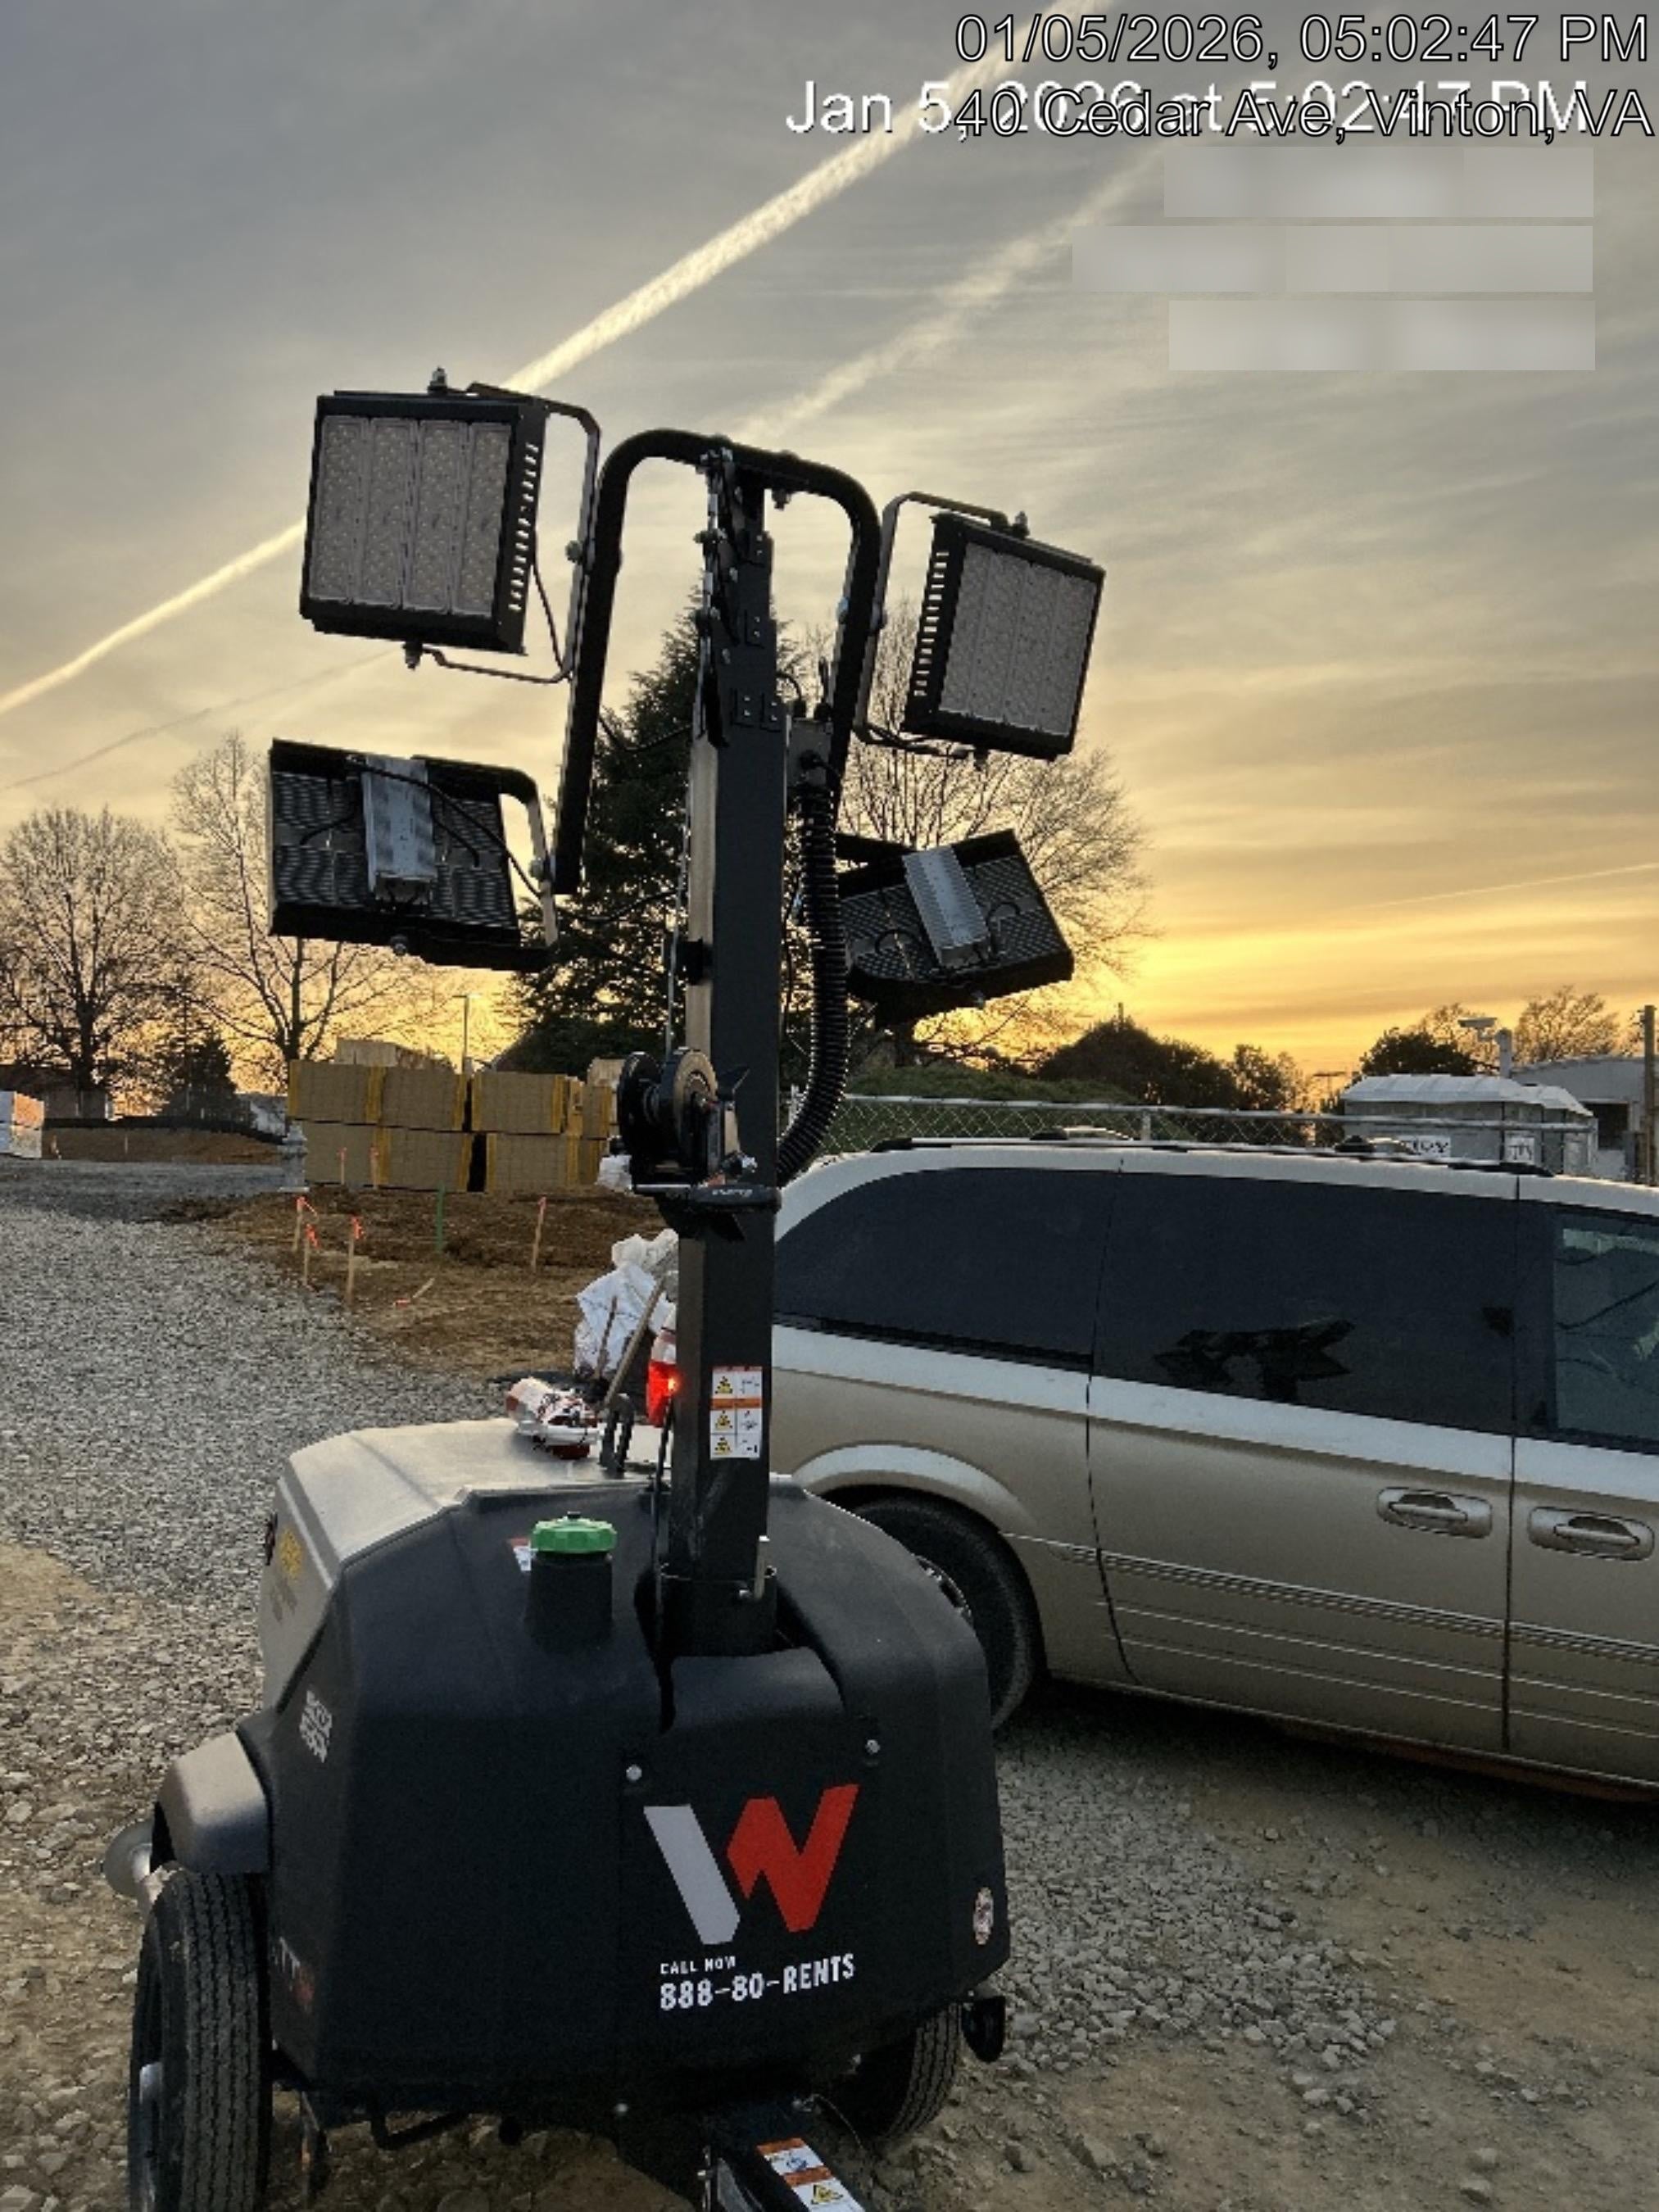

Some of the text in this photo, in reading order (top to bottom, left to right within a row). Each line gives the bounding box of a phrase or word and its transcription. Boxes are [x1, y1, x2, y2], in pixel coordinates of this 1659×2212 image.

[660, 1956, 737, 1975] CALL NOW
[660, 1952, 854, 2011] 888-80-RENTS
